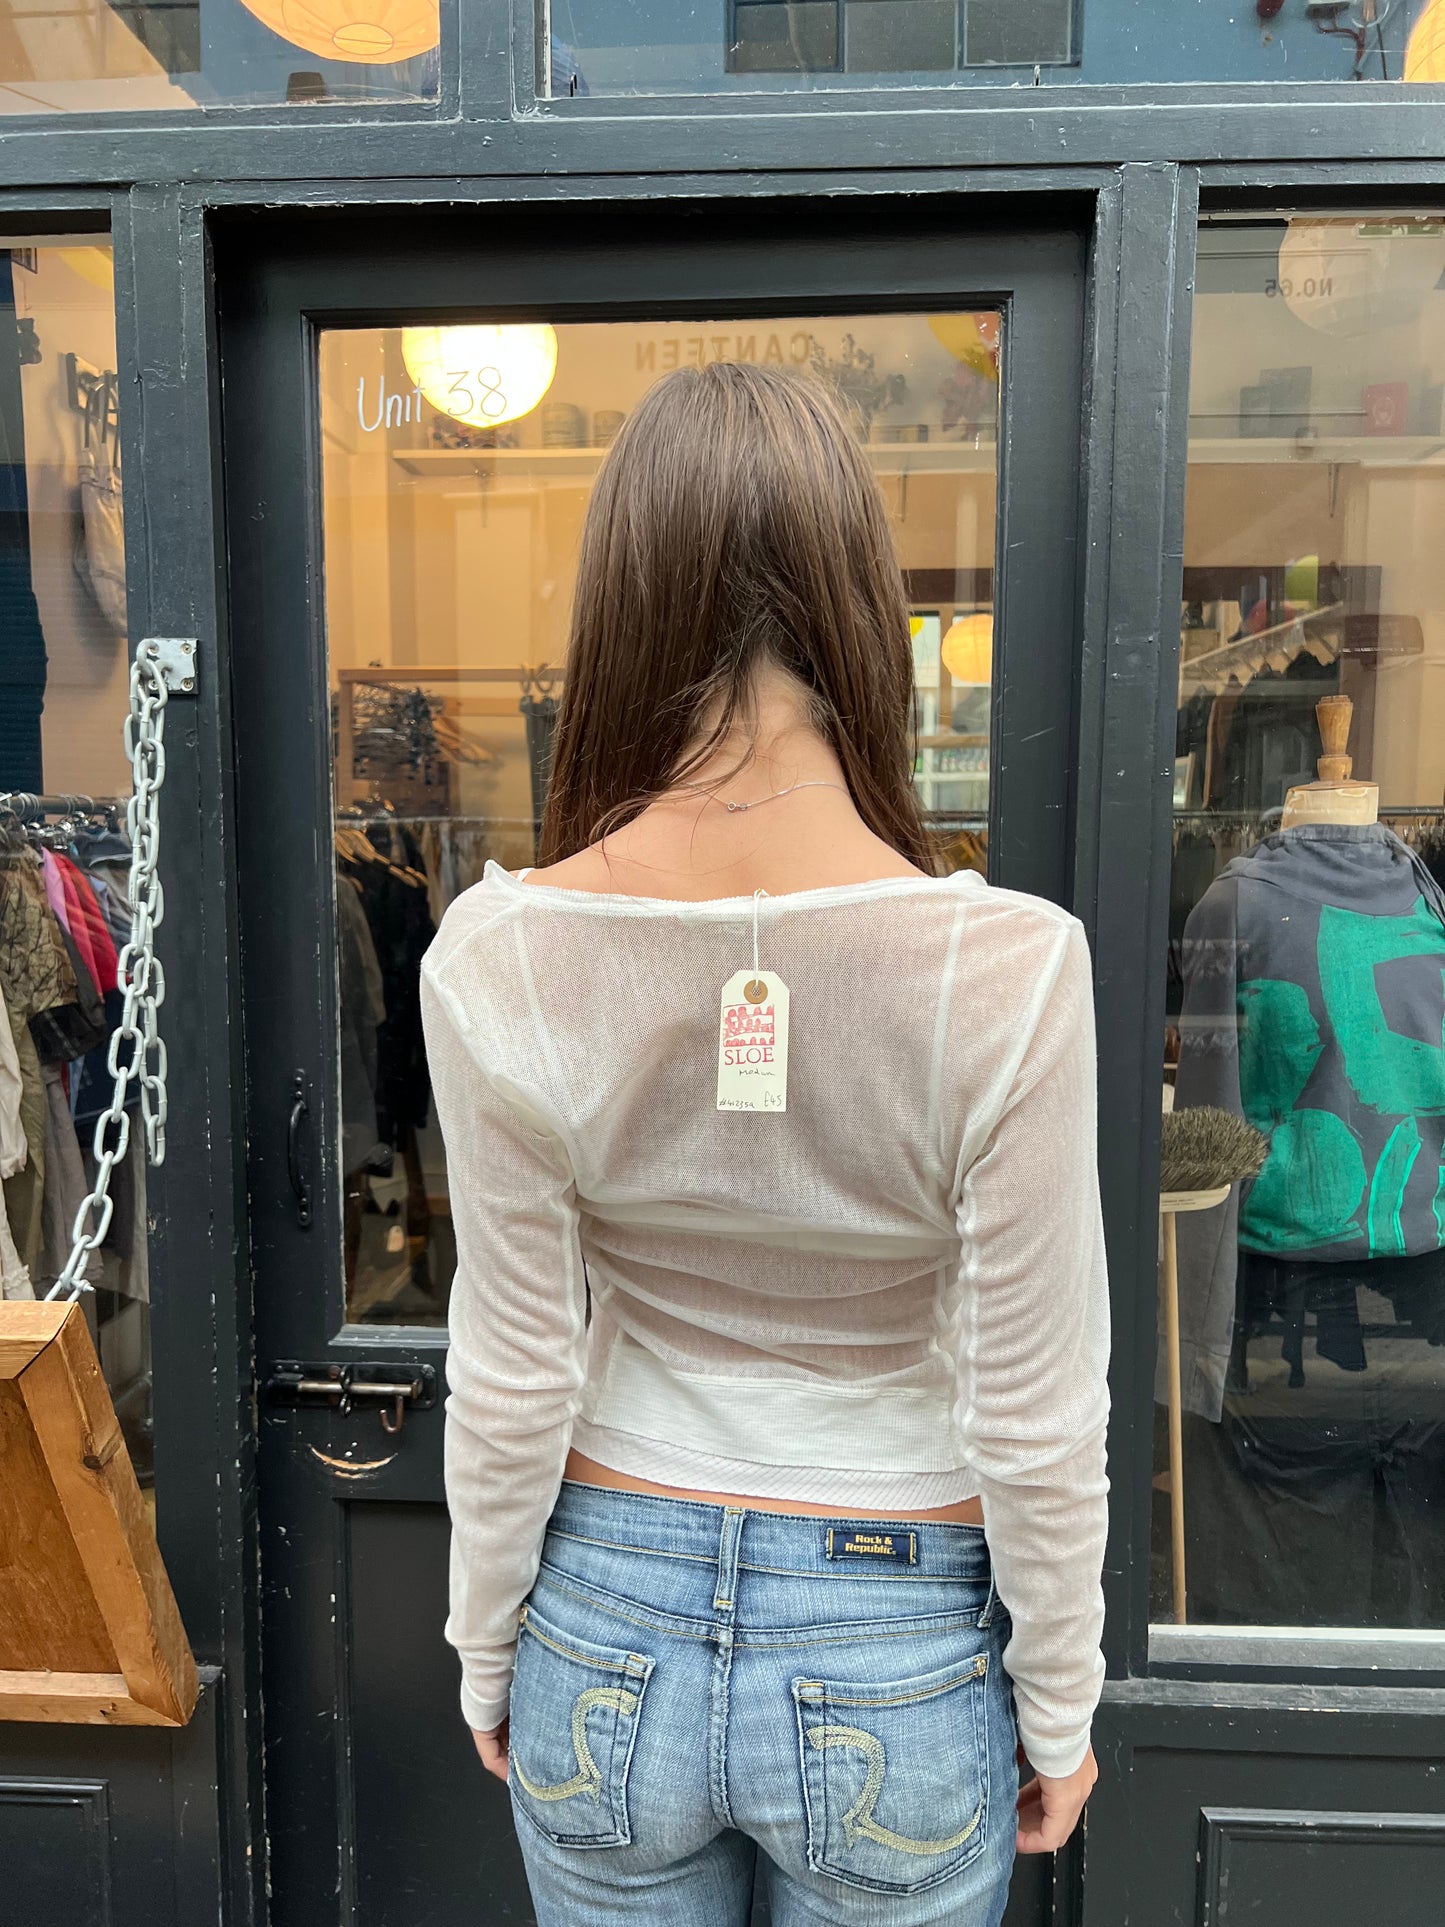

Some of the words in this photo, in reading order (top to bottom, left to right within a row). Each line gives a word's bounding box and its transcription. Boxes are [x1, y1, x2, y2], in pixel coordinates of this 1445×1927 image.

[358, 375, 426, 432] Unit
[446, 366, 507, 418] 38
[724, 1047, 774, 1066] SLOE
[855, 1534, 881, 1545] Rock
[884, 1536, 893, 1545] &
